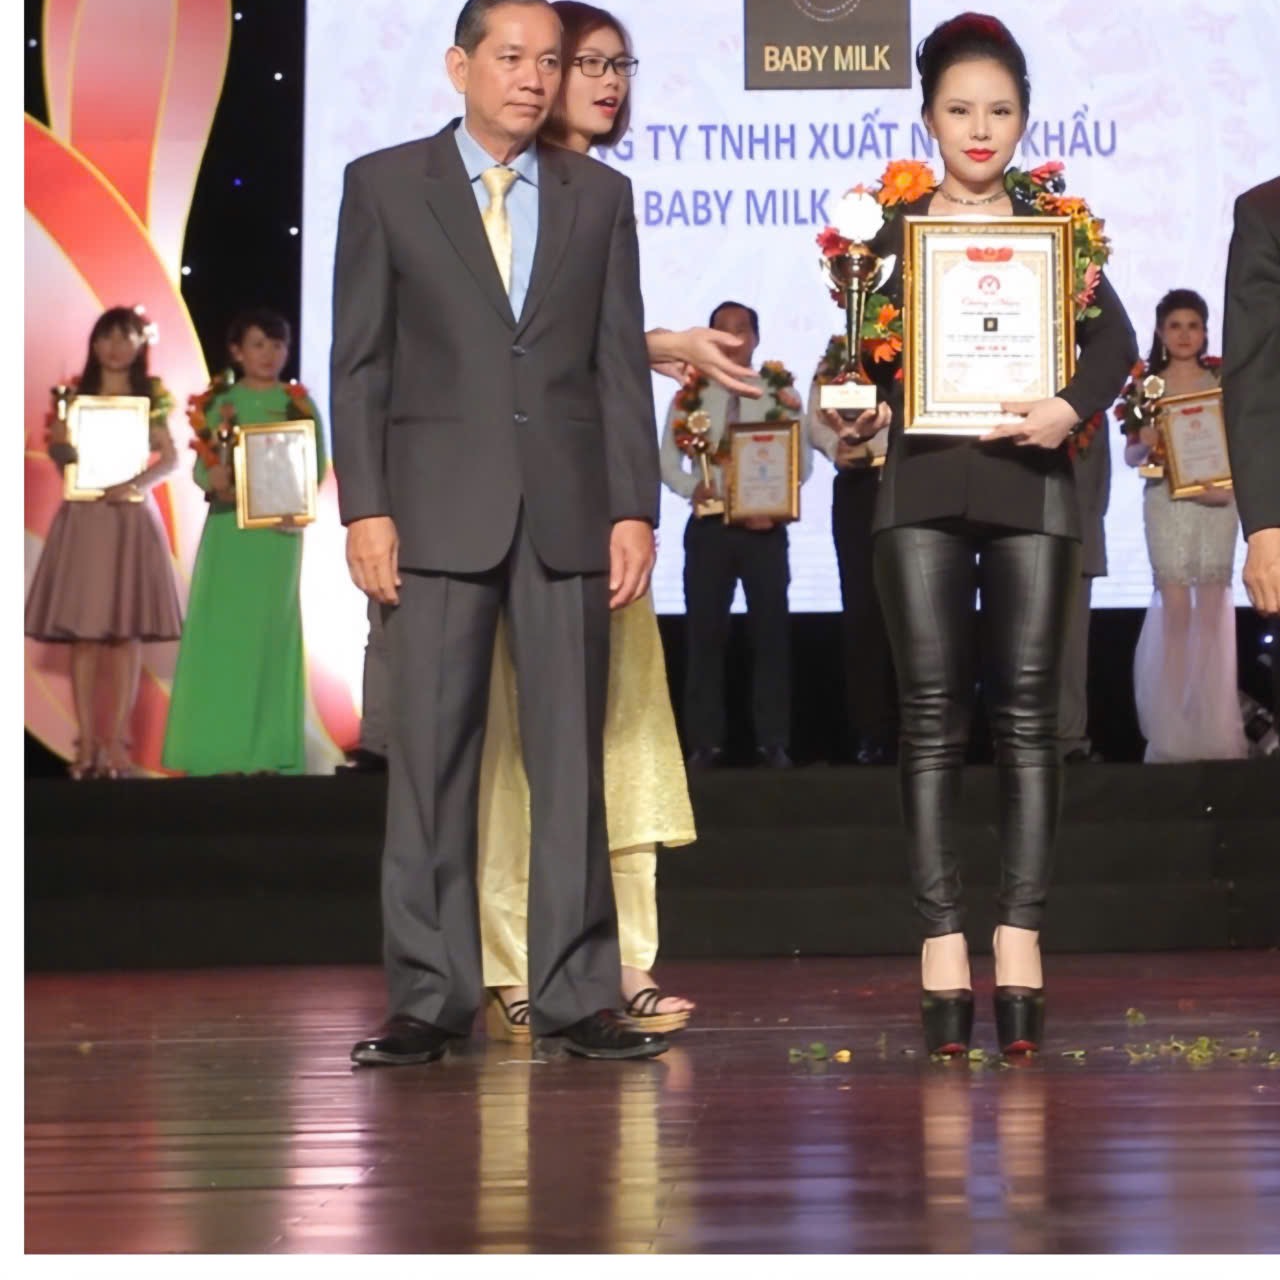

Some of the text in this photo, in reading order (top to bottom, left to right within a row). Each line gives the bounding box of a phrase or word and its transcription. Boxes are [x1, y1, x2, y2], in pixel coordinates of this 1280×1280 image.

[764, 45, 890, 71] BABY MILK
[646, 124, 688, 160] TY
[698, 124, 795, 160] TNHH
[808, 108, 898, 158] XUẤT
[644, 189, 831, 226] BABY MILK
